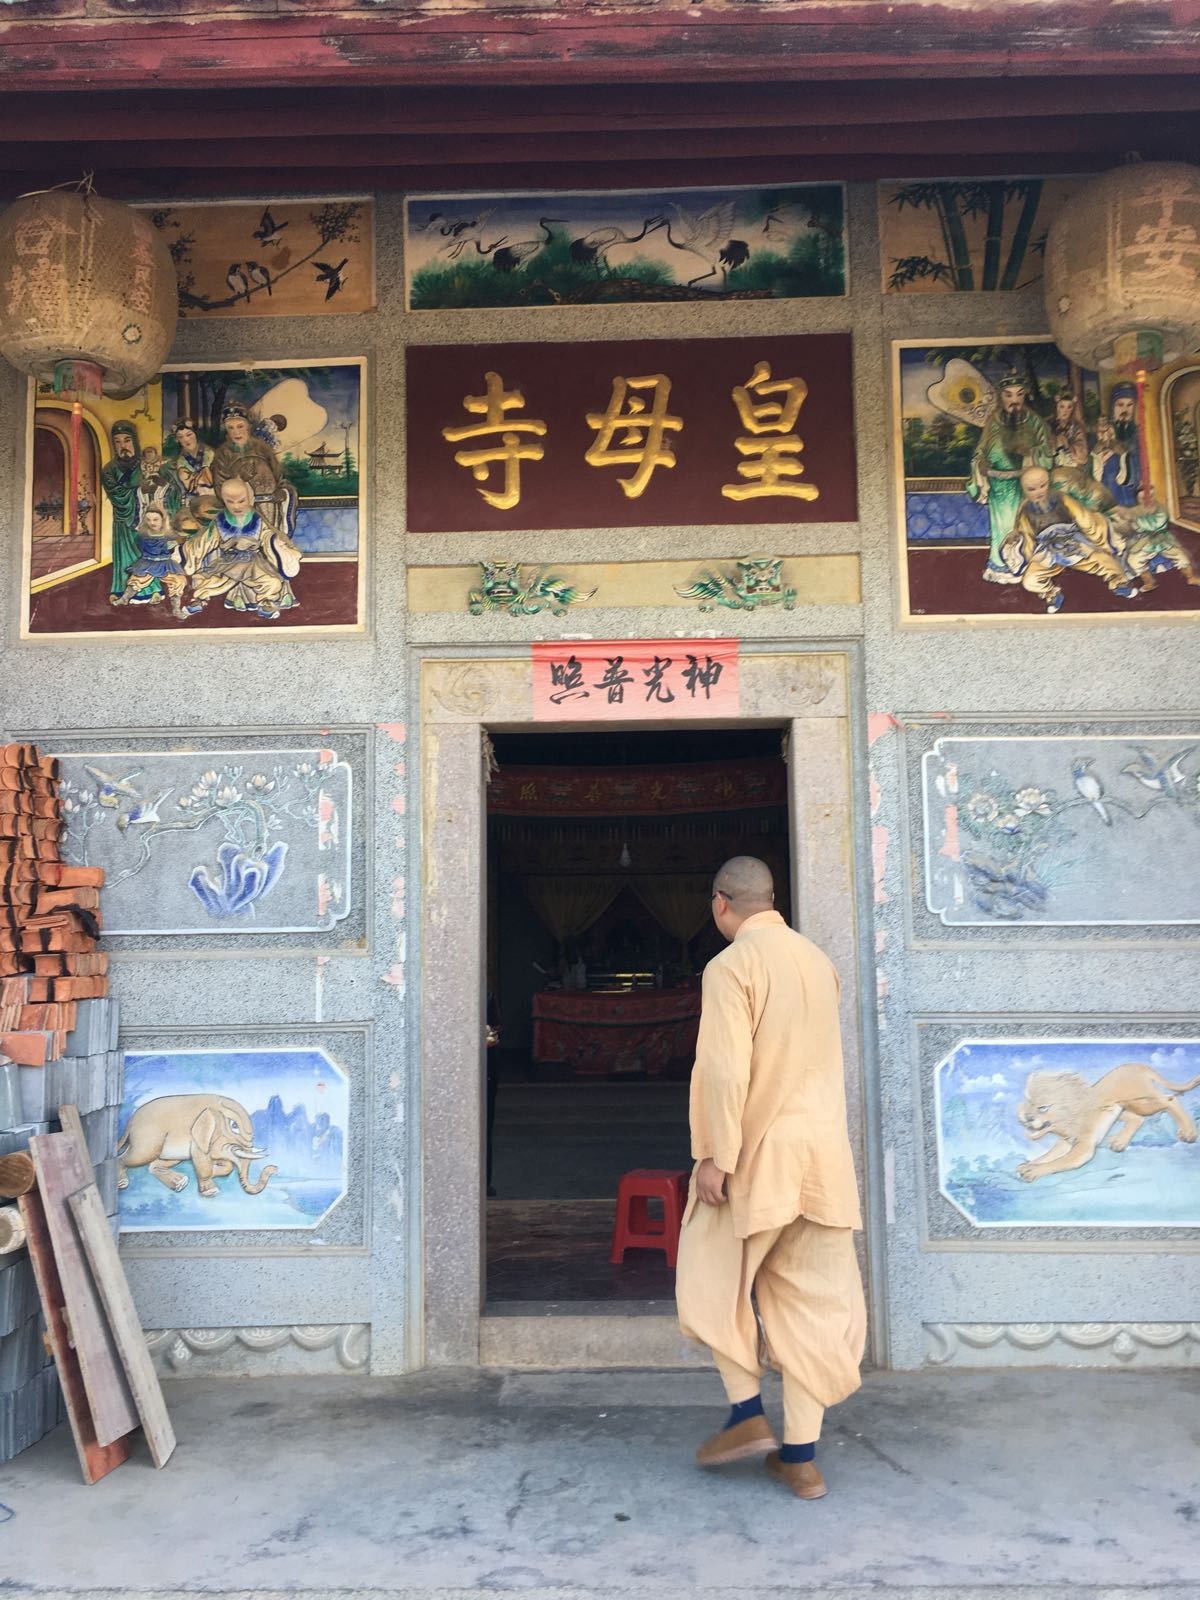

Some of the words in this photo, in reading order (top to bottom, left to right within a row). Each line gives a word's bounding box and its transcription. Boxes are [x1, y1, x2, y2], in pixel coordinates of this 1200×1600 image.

[442, 361, 820, 510] 皇母寺
[549, 655, 723, 704] 神光普照
